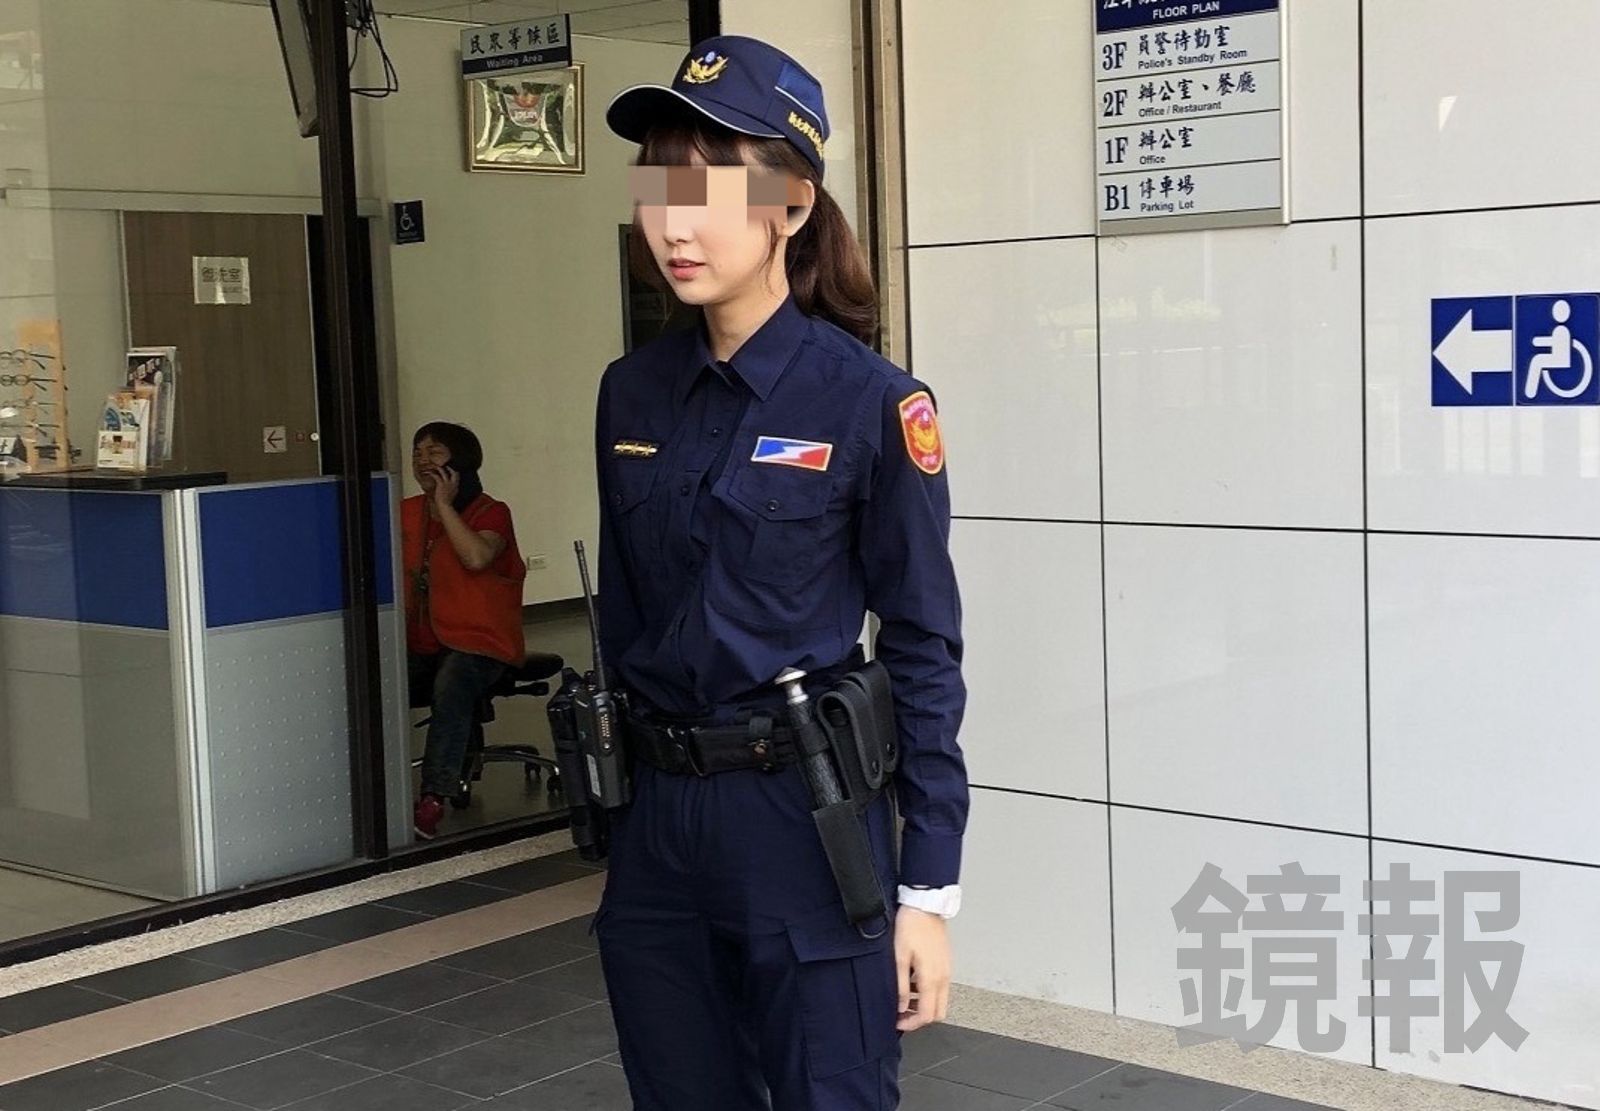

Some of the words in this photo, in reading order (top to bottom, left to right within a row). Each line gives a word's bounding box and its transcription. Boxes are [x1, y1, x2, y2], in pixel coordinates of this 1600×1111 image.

[1152, 6, 1188, 19] FLOOR
[1191, 2, 1220, 14] PLAN
[1139, 25, 1230, 55] 員警待勤室
[486, 58, 519, 69] Waiting
[522, 54, 543, 65] Area
[1102, 42, 1128, 71] 3F
[1138, 57, 1173, 70] Police's
[1177, 53, 1216, 65] Standby
[1220, 49, 1248, 60] Room
[1103, 89, 1128, 118] 2F
[1138, 107, 1166, 118] Office
[1172, 101, 1222, 114] Restaurant
[1138, 126, 1194, 150] 辦公室
[1104, 137, 1129, 165] 1F
[1139, 155, 1166, 166] Office
[1104, 184, 1131, 212] B1
[1139, 174, 1195, 199] 停車場
[1140, 202, 1174, 214] Parking
[1178, 199, 1195, 210] Lot
